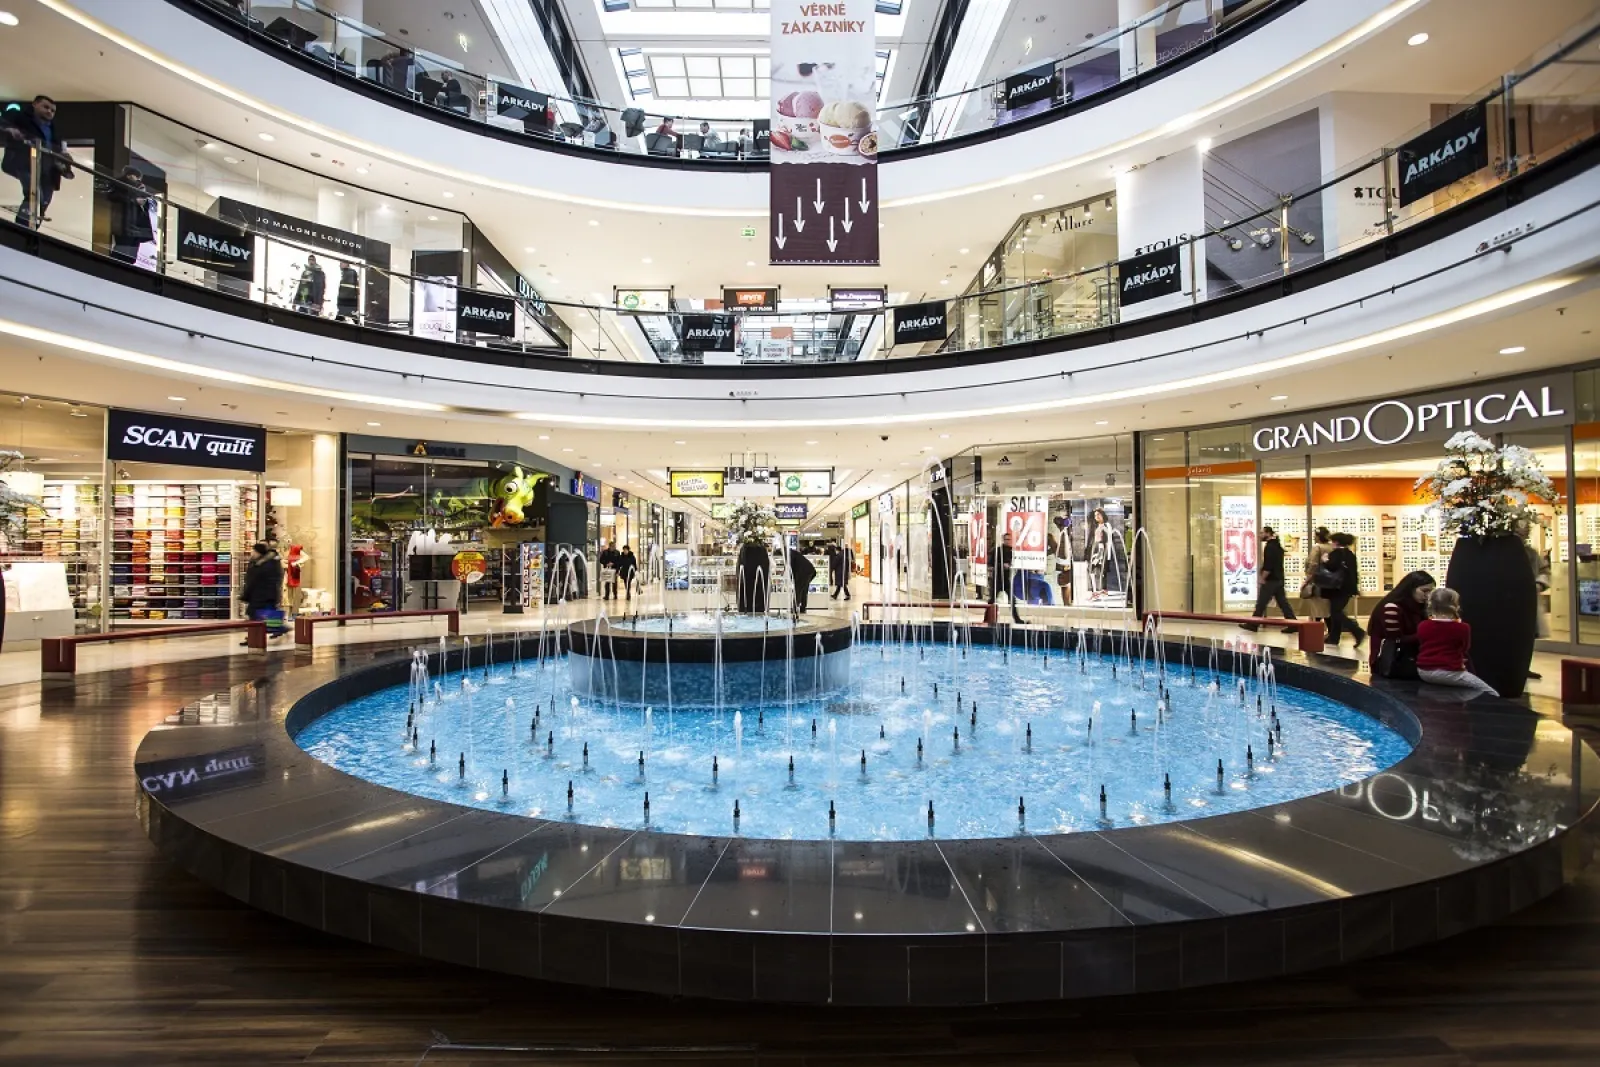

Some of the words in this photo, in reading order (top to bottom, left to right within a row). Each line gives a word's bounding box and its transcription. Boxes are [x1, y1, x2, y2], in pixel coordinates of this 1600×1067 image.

[800, 2, 846, 17] VĚRNÉ
[781, 19, 866, 34] ZÁKAZNÍKY
[1009, 74, 1053, 99] ARKÁDY
[501, 95, 545, 113] ARKÁDY
[1404, 127, 1481, 185] ARKÁDY
[256, 216, 269, 225] JO
[273, 220, 317, 238] MALONE
[321, 233, 362, 250] LONDON
[1052, 216, 1095, 234] Allure
[184, 231, 251, 261] ARKÁDY
[1123, 263, 1177, 292] ARKÁDY
[461, 305, 512, 322] ARKÁDY
[897, 315, 943, 333] ARKÁDY
[686, 328, 732, 340] ARKÁDY
[1252, 386, 1565, 452] GRANDOPTICAL
[122, 425, 204, 450] SCAN
[205, 438, 254, 456] quilt
[1010, 496, 1042, 513] SALE
[1224, 517, 1254, 529] SLEVY
[1224, 530, 1257, 572] 50
